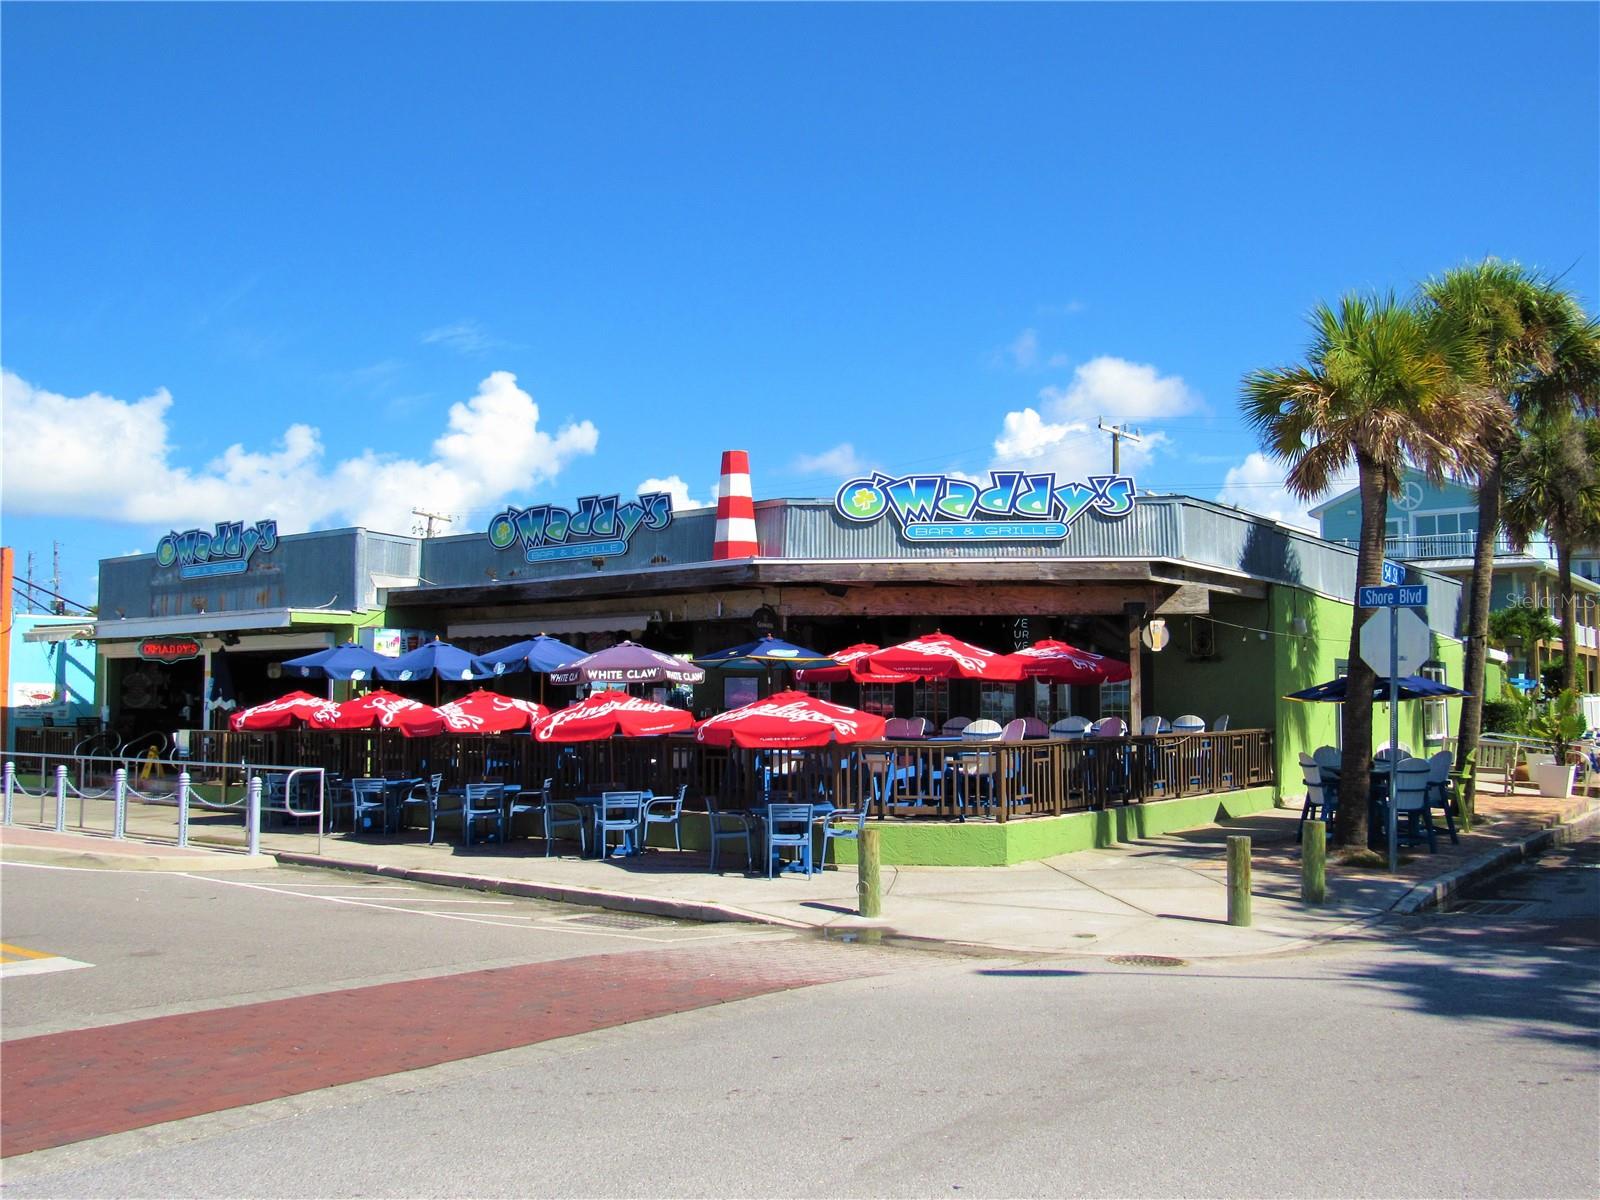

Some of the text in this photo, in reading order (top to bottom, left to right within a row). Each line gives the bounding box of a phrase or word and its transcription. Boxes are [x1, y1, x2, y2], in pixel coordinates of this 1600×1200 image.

[836, 472, 1136, 523] O'Maddy's
[489, 494, 671, 550] O'Maddy's
[914, 525, 1058, 537] BAR & GRILLE
[530, 549, 553, 560] BAR
[571, 545, 619, 556] GRILLE
[1365, 588, 1422, 605] Shore Blvd
[549, 672, 569, 682] WHITE
[587, 668, 658, 680] WHITE CLAW
[665, 669, 703, 681] WHITE CLAW
